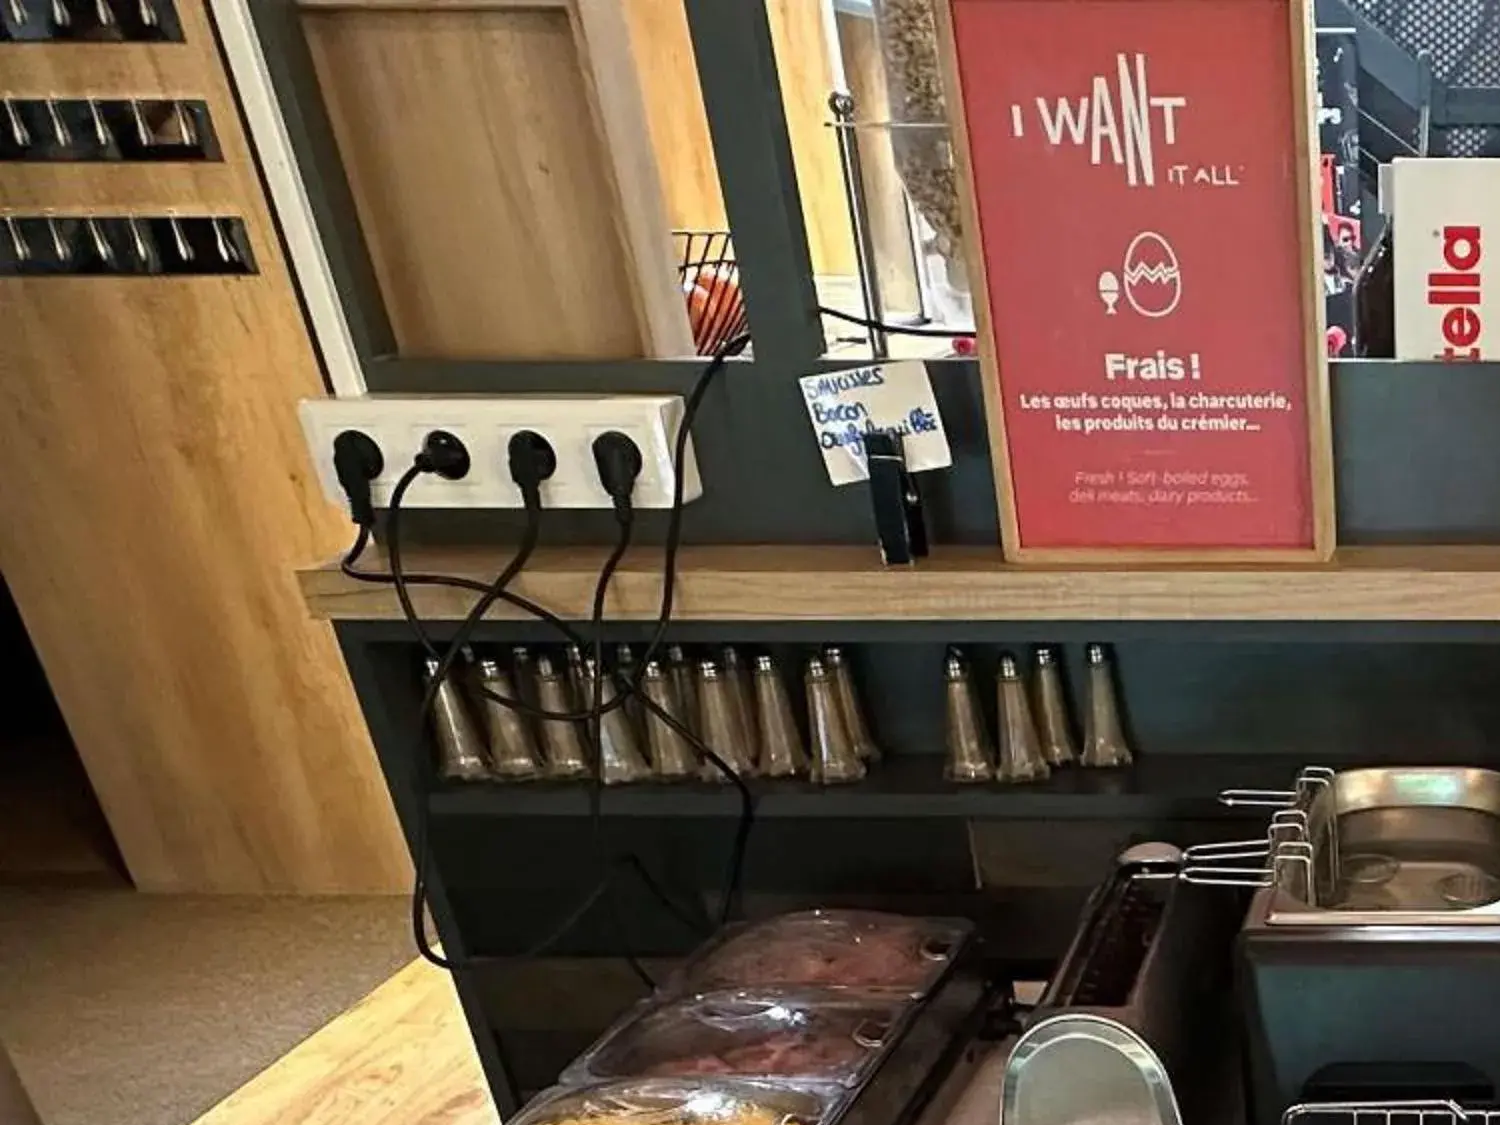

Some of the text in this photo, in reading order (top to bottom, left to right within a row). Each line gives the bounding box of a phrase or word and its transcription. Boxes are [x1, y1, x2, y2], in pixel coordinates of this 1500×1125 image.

[1011, 53, 1187, 187] I WANT
[1168, 164, 1240, 186] IT ALL
[1105, 351, 1202, 381] Frais !
[1020, 391, 1292, 412] Les œufs coques, la charcuterie,
[1056, 414, 1081, 431] les
[1084, 414, 1154, 435] produits
[1157, 413, 1178, 431] du
